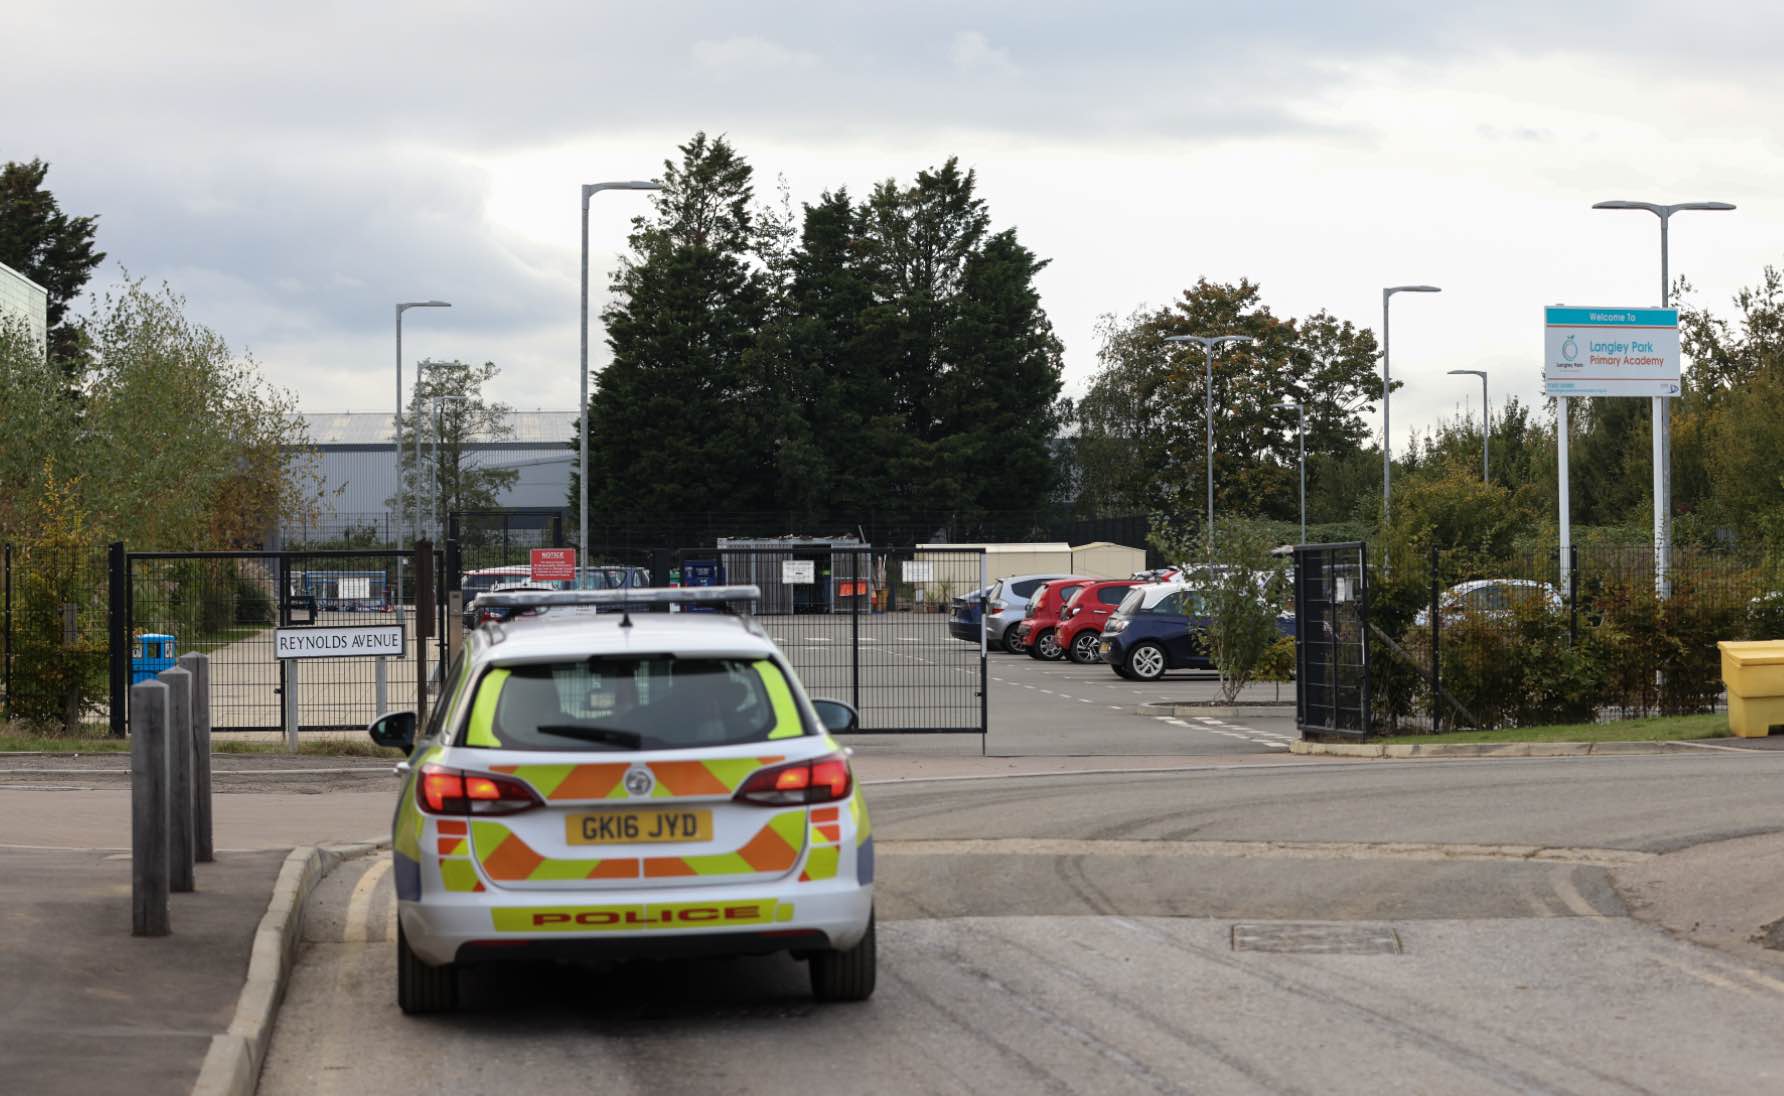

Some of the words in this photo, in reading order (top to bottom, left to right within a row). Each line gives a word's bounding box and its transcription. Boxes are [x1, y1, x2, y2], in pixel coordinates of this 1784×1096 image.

[1588, 312, 1625, 321] Welcome
[1627, 313, 1636, 322] To
[1589, 341, 1629, 354] Langley
[1632, 341, 1653, 353] Park
[1589, 355, 1623, 367] Primary
[1624, 356, 1664, 367] Academy
[541, 551, 565, 560] NOTICE
[280, 635, 347, 650] REYNOLDS
[351, 633, 398, 648] AVENUE
[581, 815, 640, 840] GK16
[648, 814, 697, 838] JYD
[532, 905, 760, 926] POLICE
